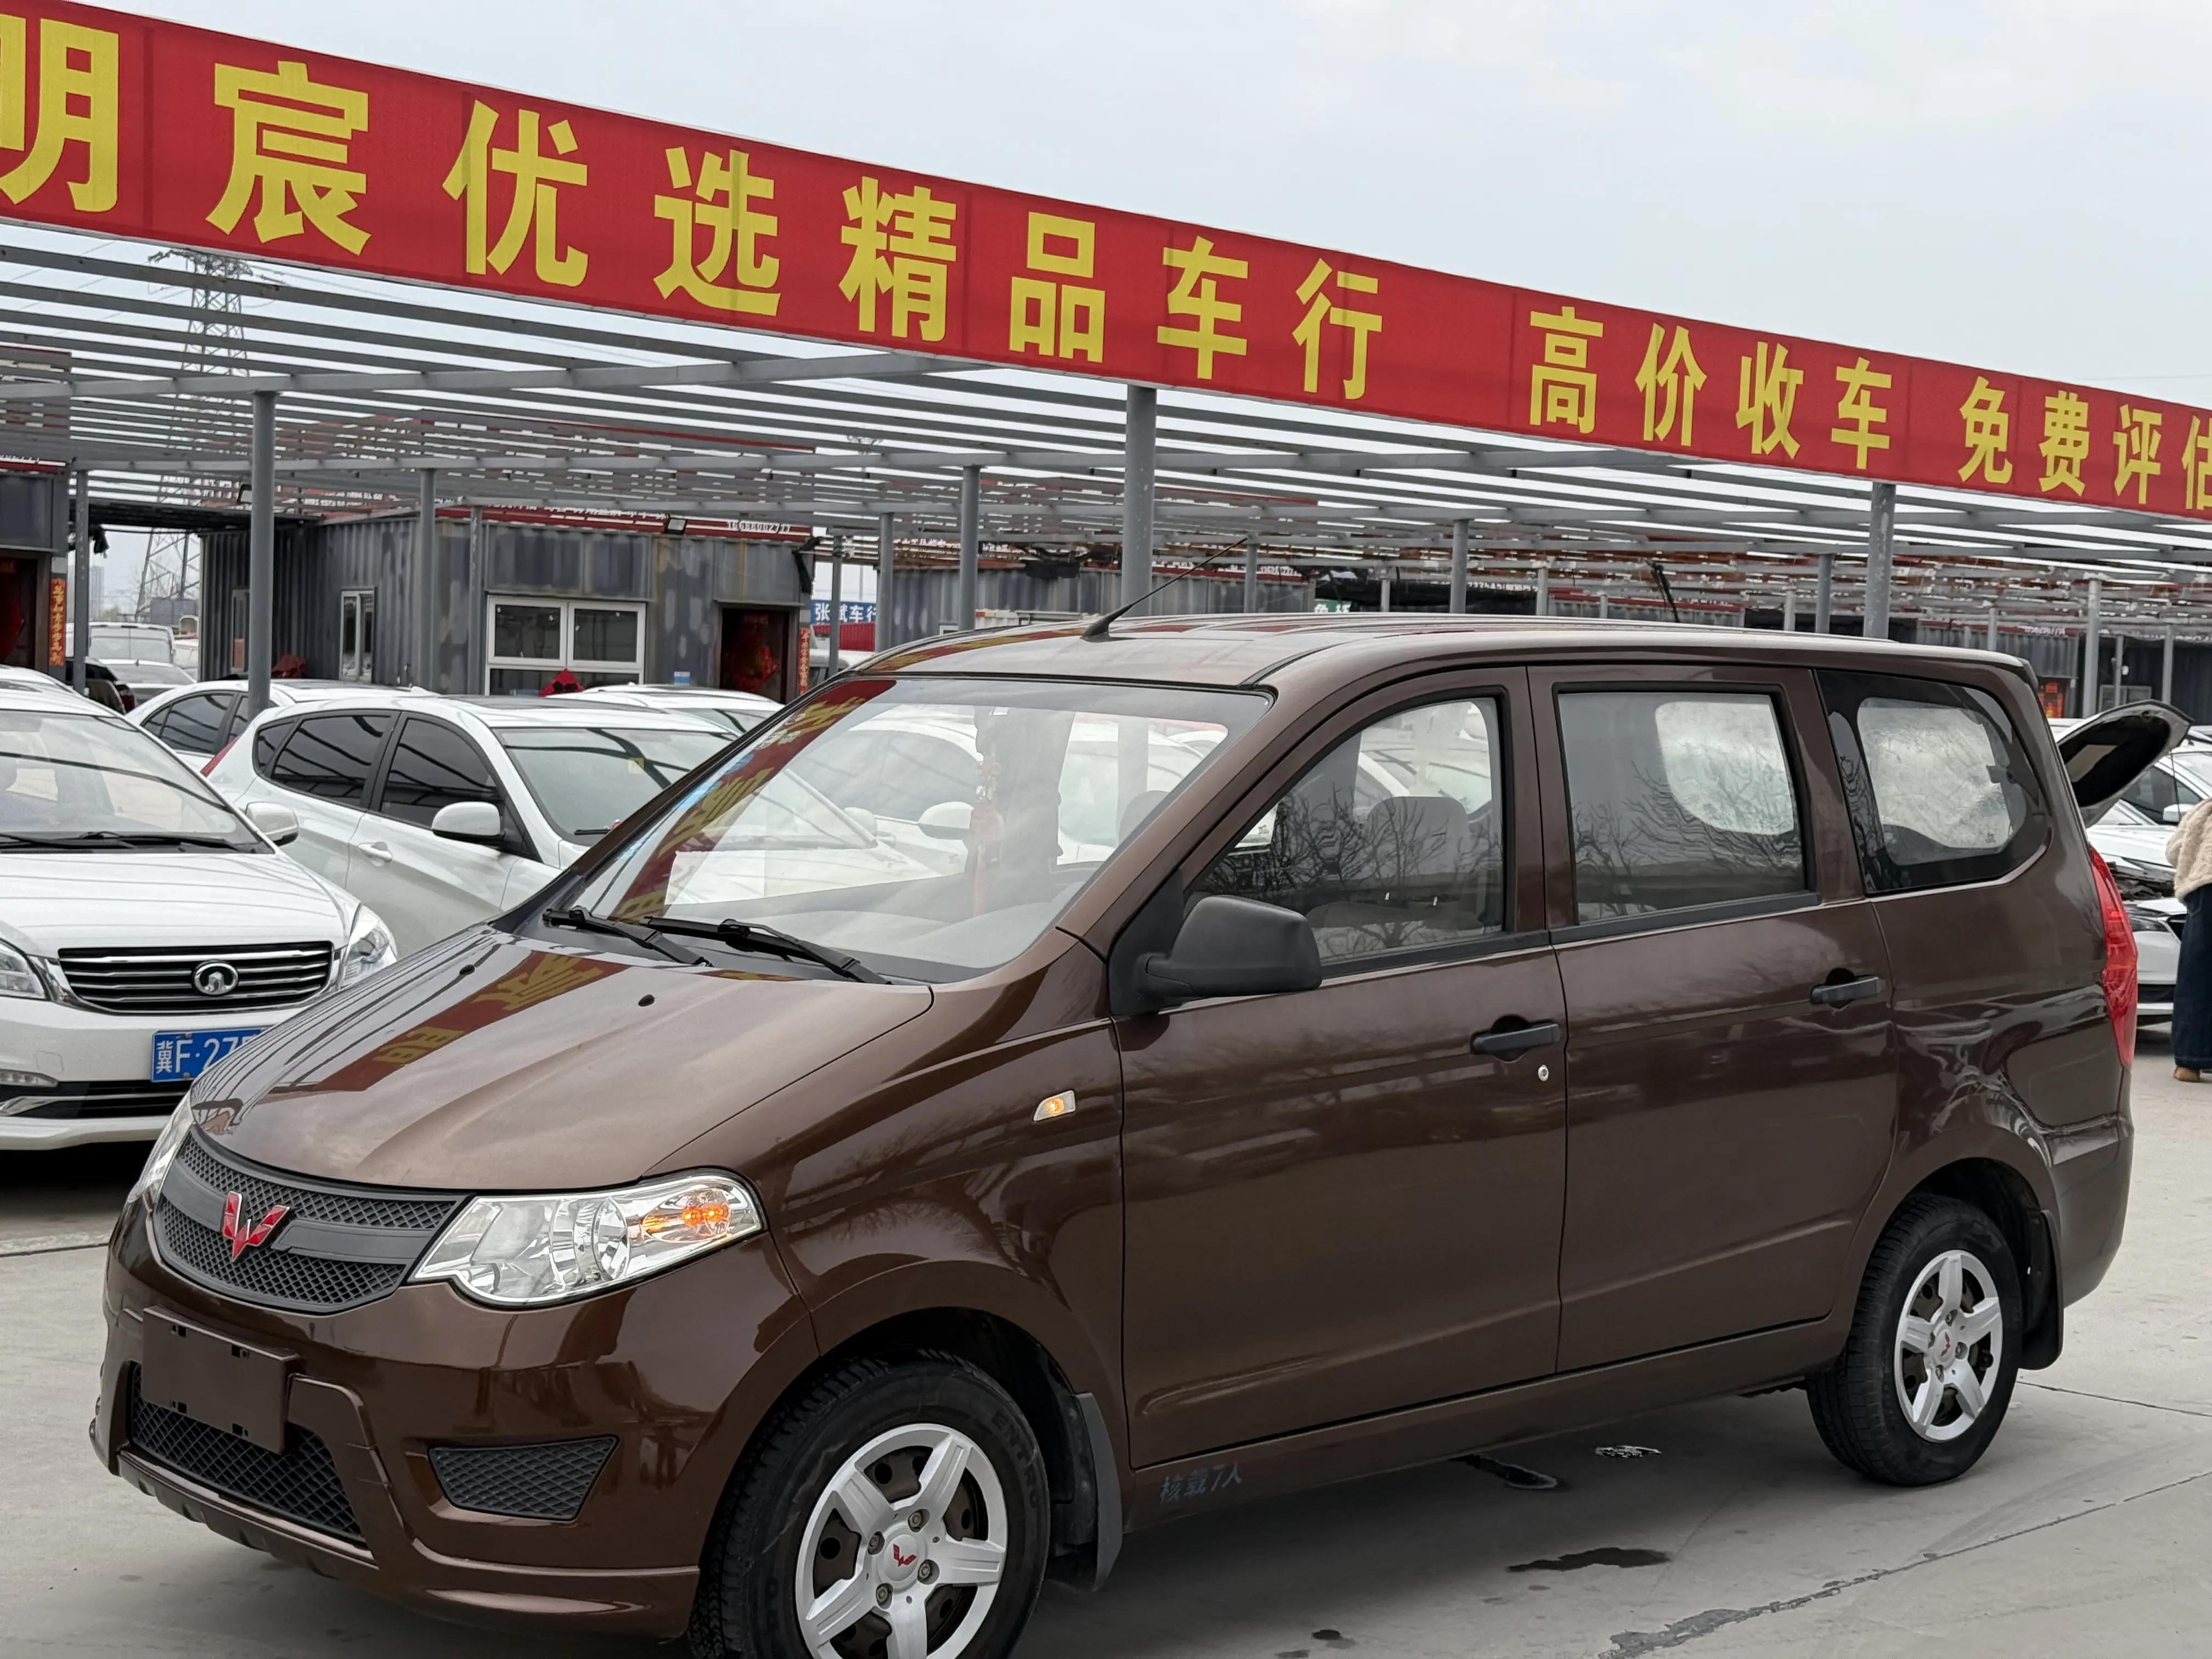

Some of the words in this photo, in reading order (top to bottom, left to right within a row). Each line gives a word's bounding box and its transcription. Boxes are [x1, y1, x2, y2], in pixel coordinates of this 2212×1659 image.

[0, 14, 1381, 399] 明宸优选精品车行
[1530, 307, 1891, 468] 高价收车
[1958, 376, 2212, 510] 免费评估
[156, 1035, 253, 1074] 冀F·27
[1159, 1460, 1243, 1505] 核载7人
